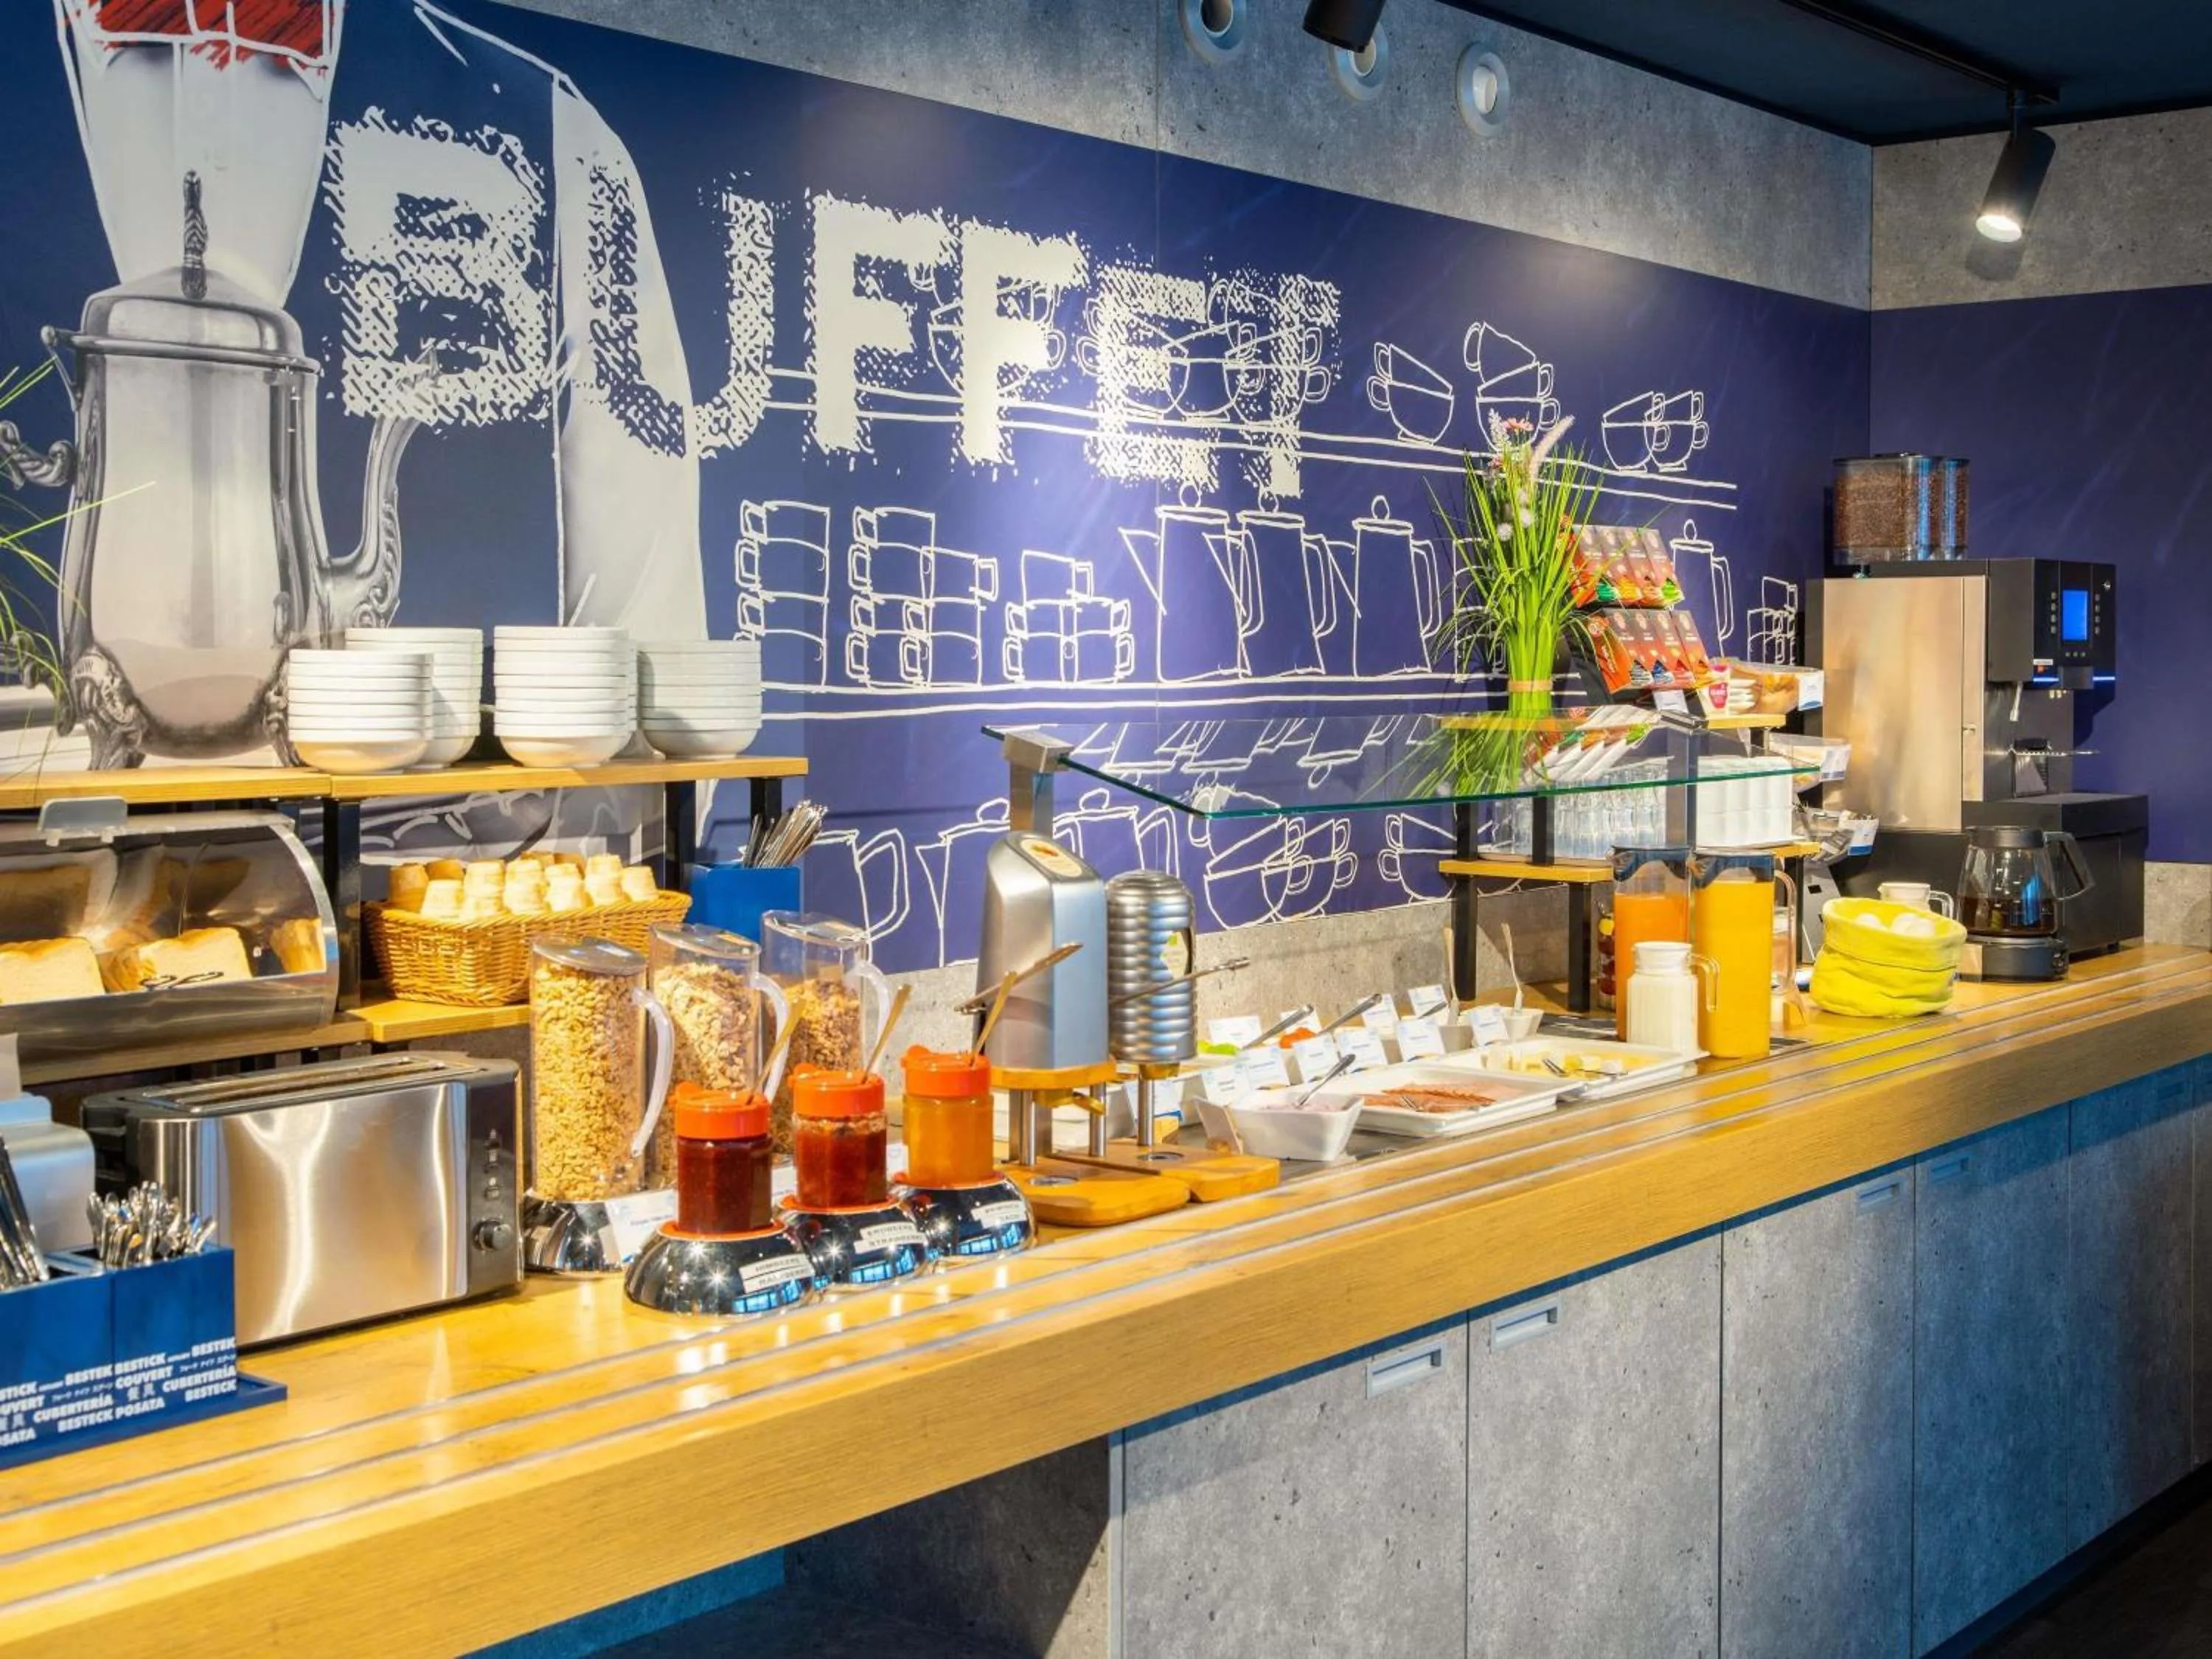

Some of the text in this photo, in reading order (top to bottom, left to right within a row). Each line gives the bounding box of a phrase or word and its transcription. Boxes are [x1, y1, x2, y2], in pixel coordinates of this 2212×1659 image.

[322, 105, 1340, 500] BUFFET
[191, 1336, 236, 1357] BESTEK
[64, 1364, 114, 1387] BESTEK
[114, 1352, 167, 1376] BESTICK
[115, 1365, 174, 1389] COUVERT
[161, 1363, 237, 1393] CUBERTERÍA
[0, 1380, 38, 1402] STICK
[184, 1378, 237, 1402] BESTECK
[0, 1394, 46, 1416] UVERT
[32, 1391, 114, 1424] CUBERTERÍA
[114, 1397, 166, 1420] POSATA
[57, 1408, 114, 1433] BESTECK
[0, 1427, 37, 1447] SATA
